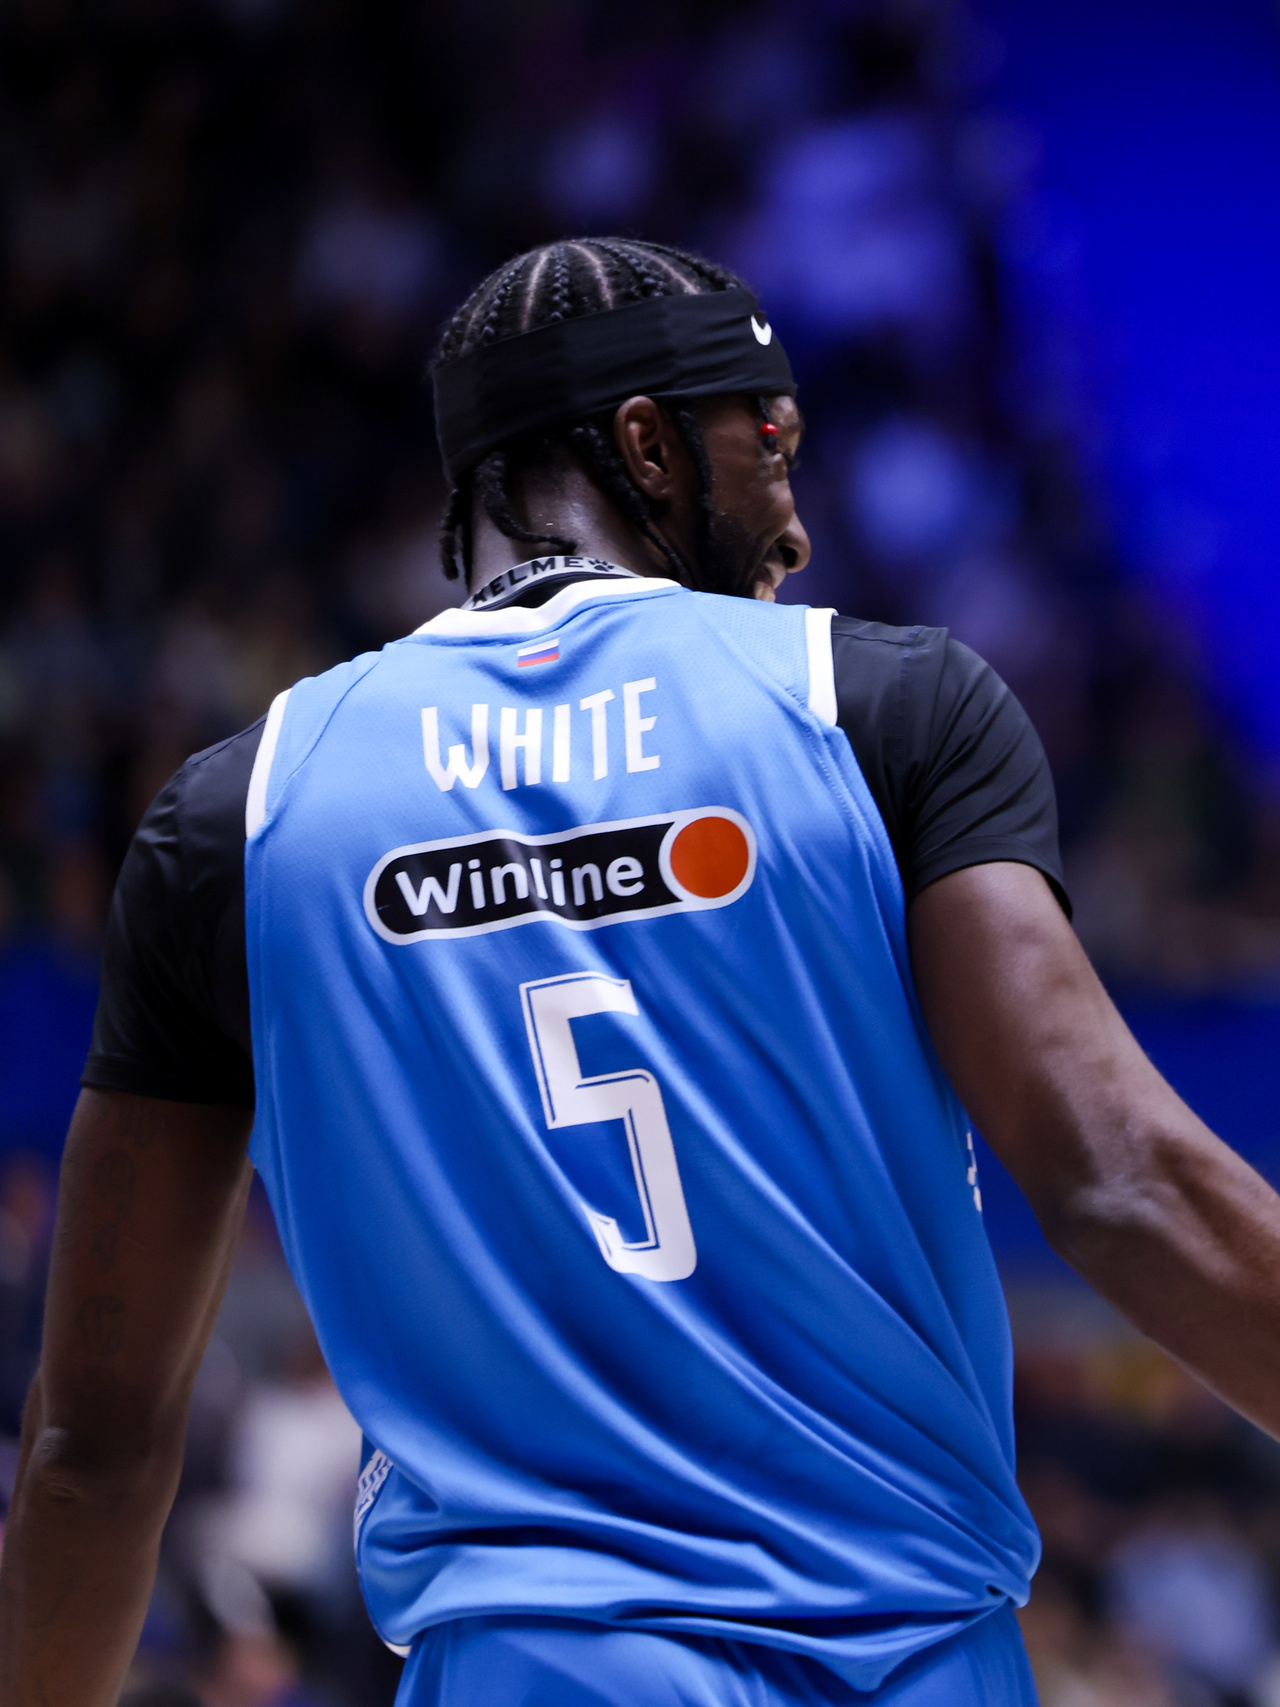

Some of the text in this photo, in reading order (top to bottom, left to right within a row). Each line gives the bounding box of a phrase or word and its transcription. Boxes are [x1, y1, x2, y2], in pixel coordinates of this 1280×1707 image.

[472, 556, 584, 607] KELME
[421, 677, 661, 792] WHITE
[519, 971, 698, 1283] 5
